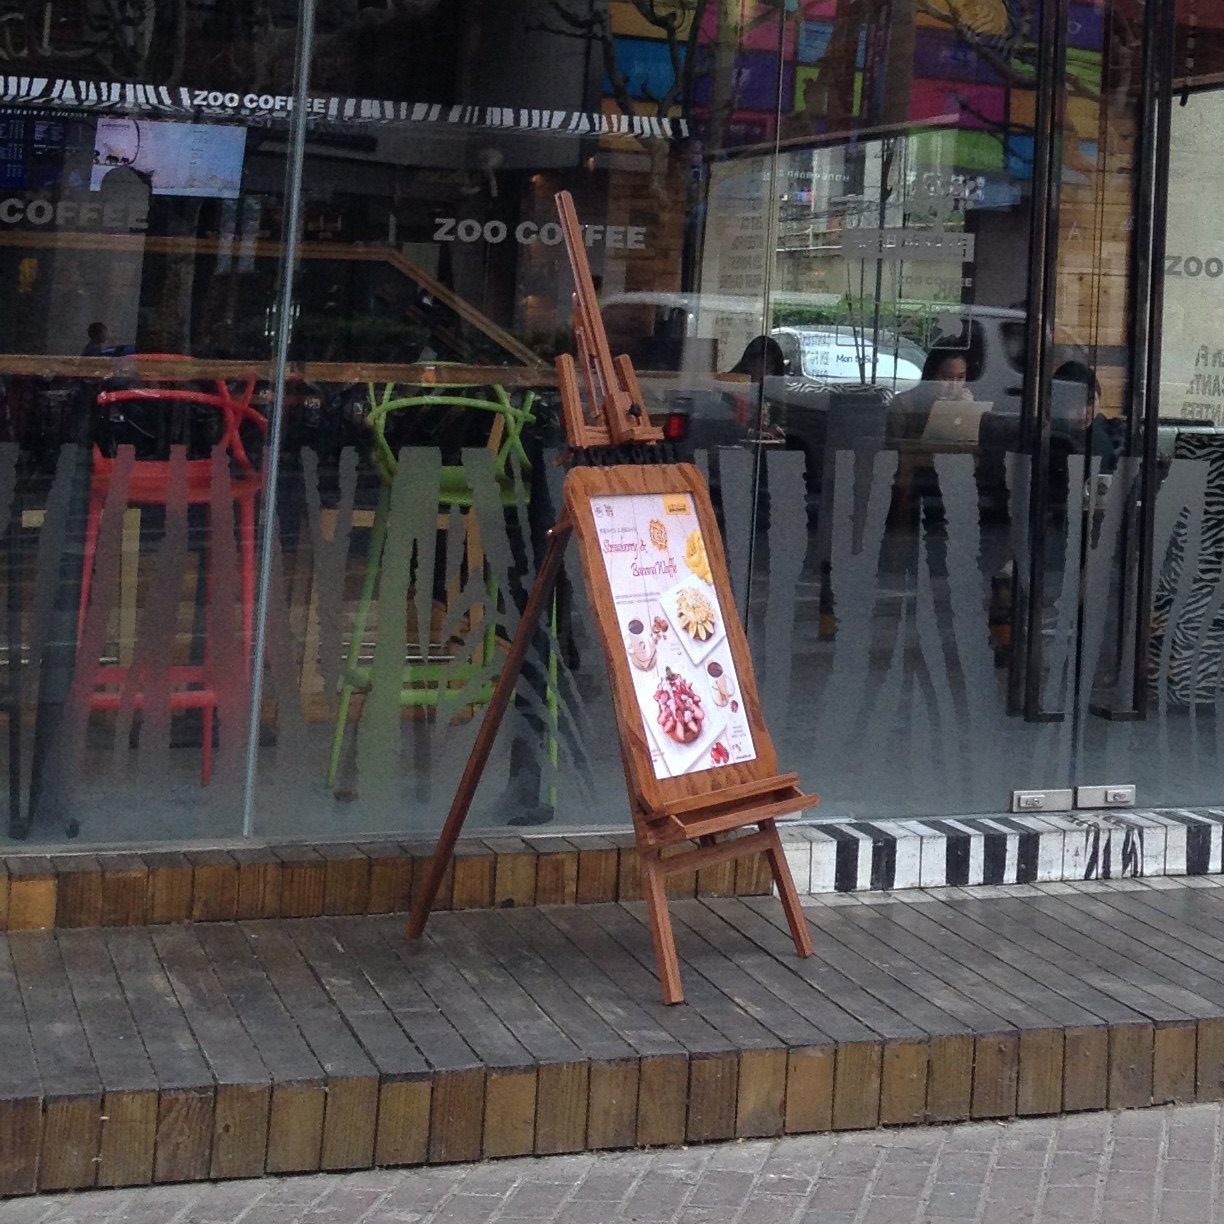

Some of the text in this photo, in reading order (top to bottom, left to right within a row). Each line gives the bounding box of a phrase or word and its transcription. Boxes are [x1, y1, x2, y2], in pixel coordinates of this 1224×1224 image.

[193, 90, 240, 108] ZOO
[433, 217, 647, 250] ZOO COFEE
[1165, 255, 1224, 278] ZOO
